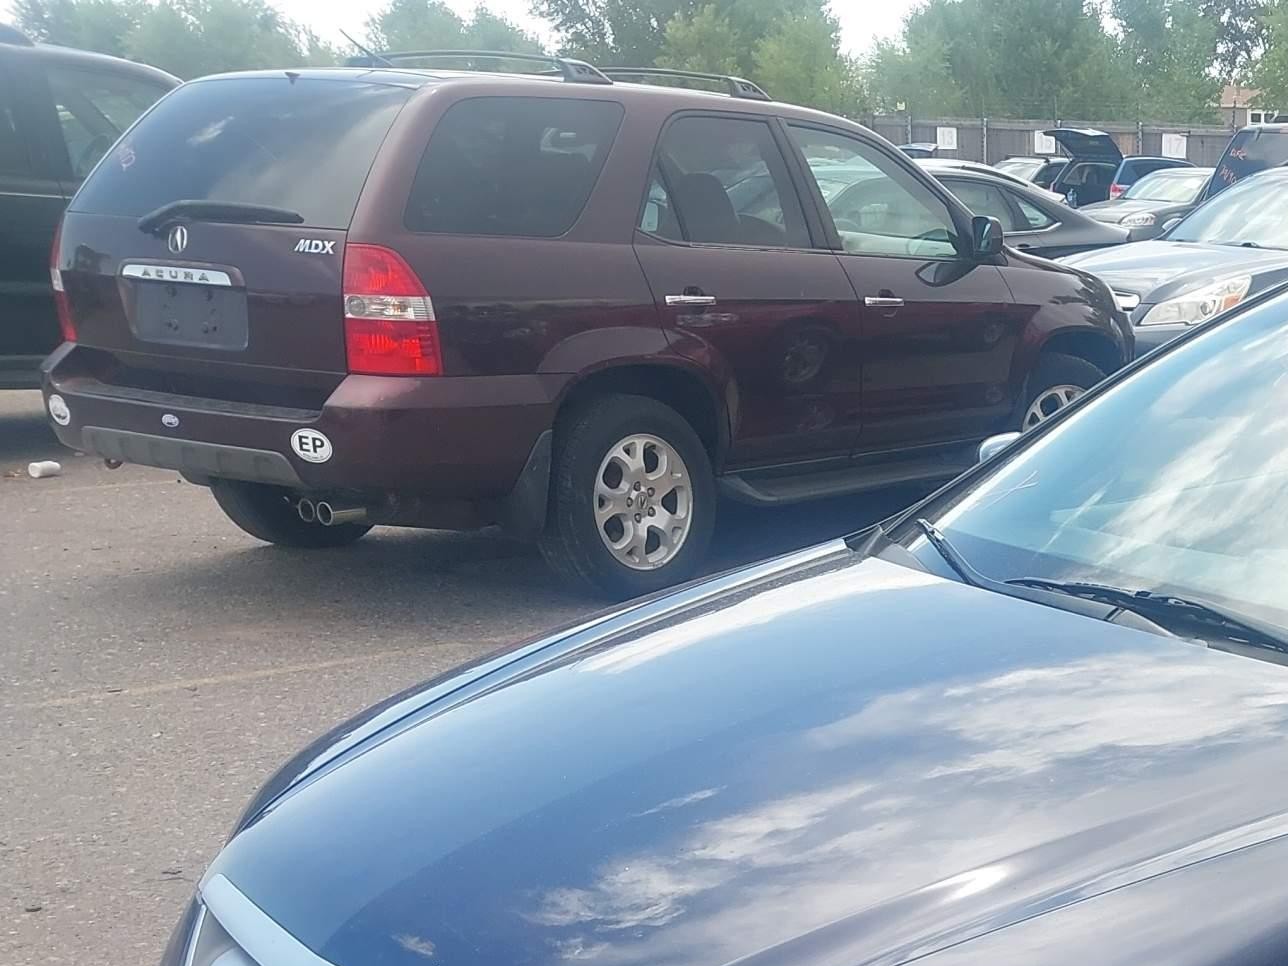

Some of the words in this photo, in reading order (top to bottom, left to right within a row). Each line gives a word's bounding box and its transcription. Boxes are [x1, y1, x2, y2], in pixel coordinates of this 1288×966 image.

[294, 238, 336, 255] MDX
[141, 267, 211, 282] ACURA
[298, 435, 325, 454] EP
